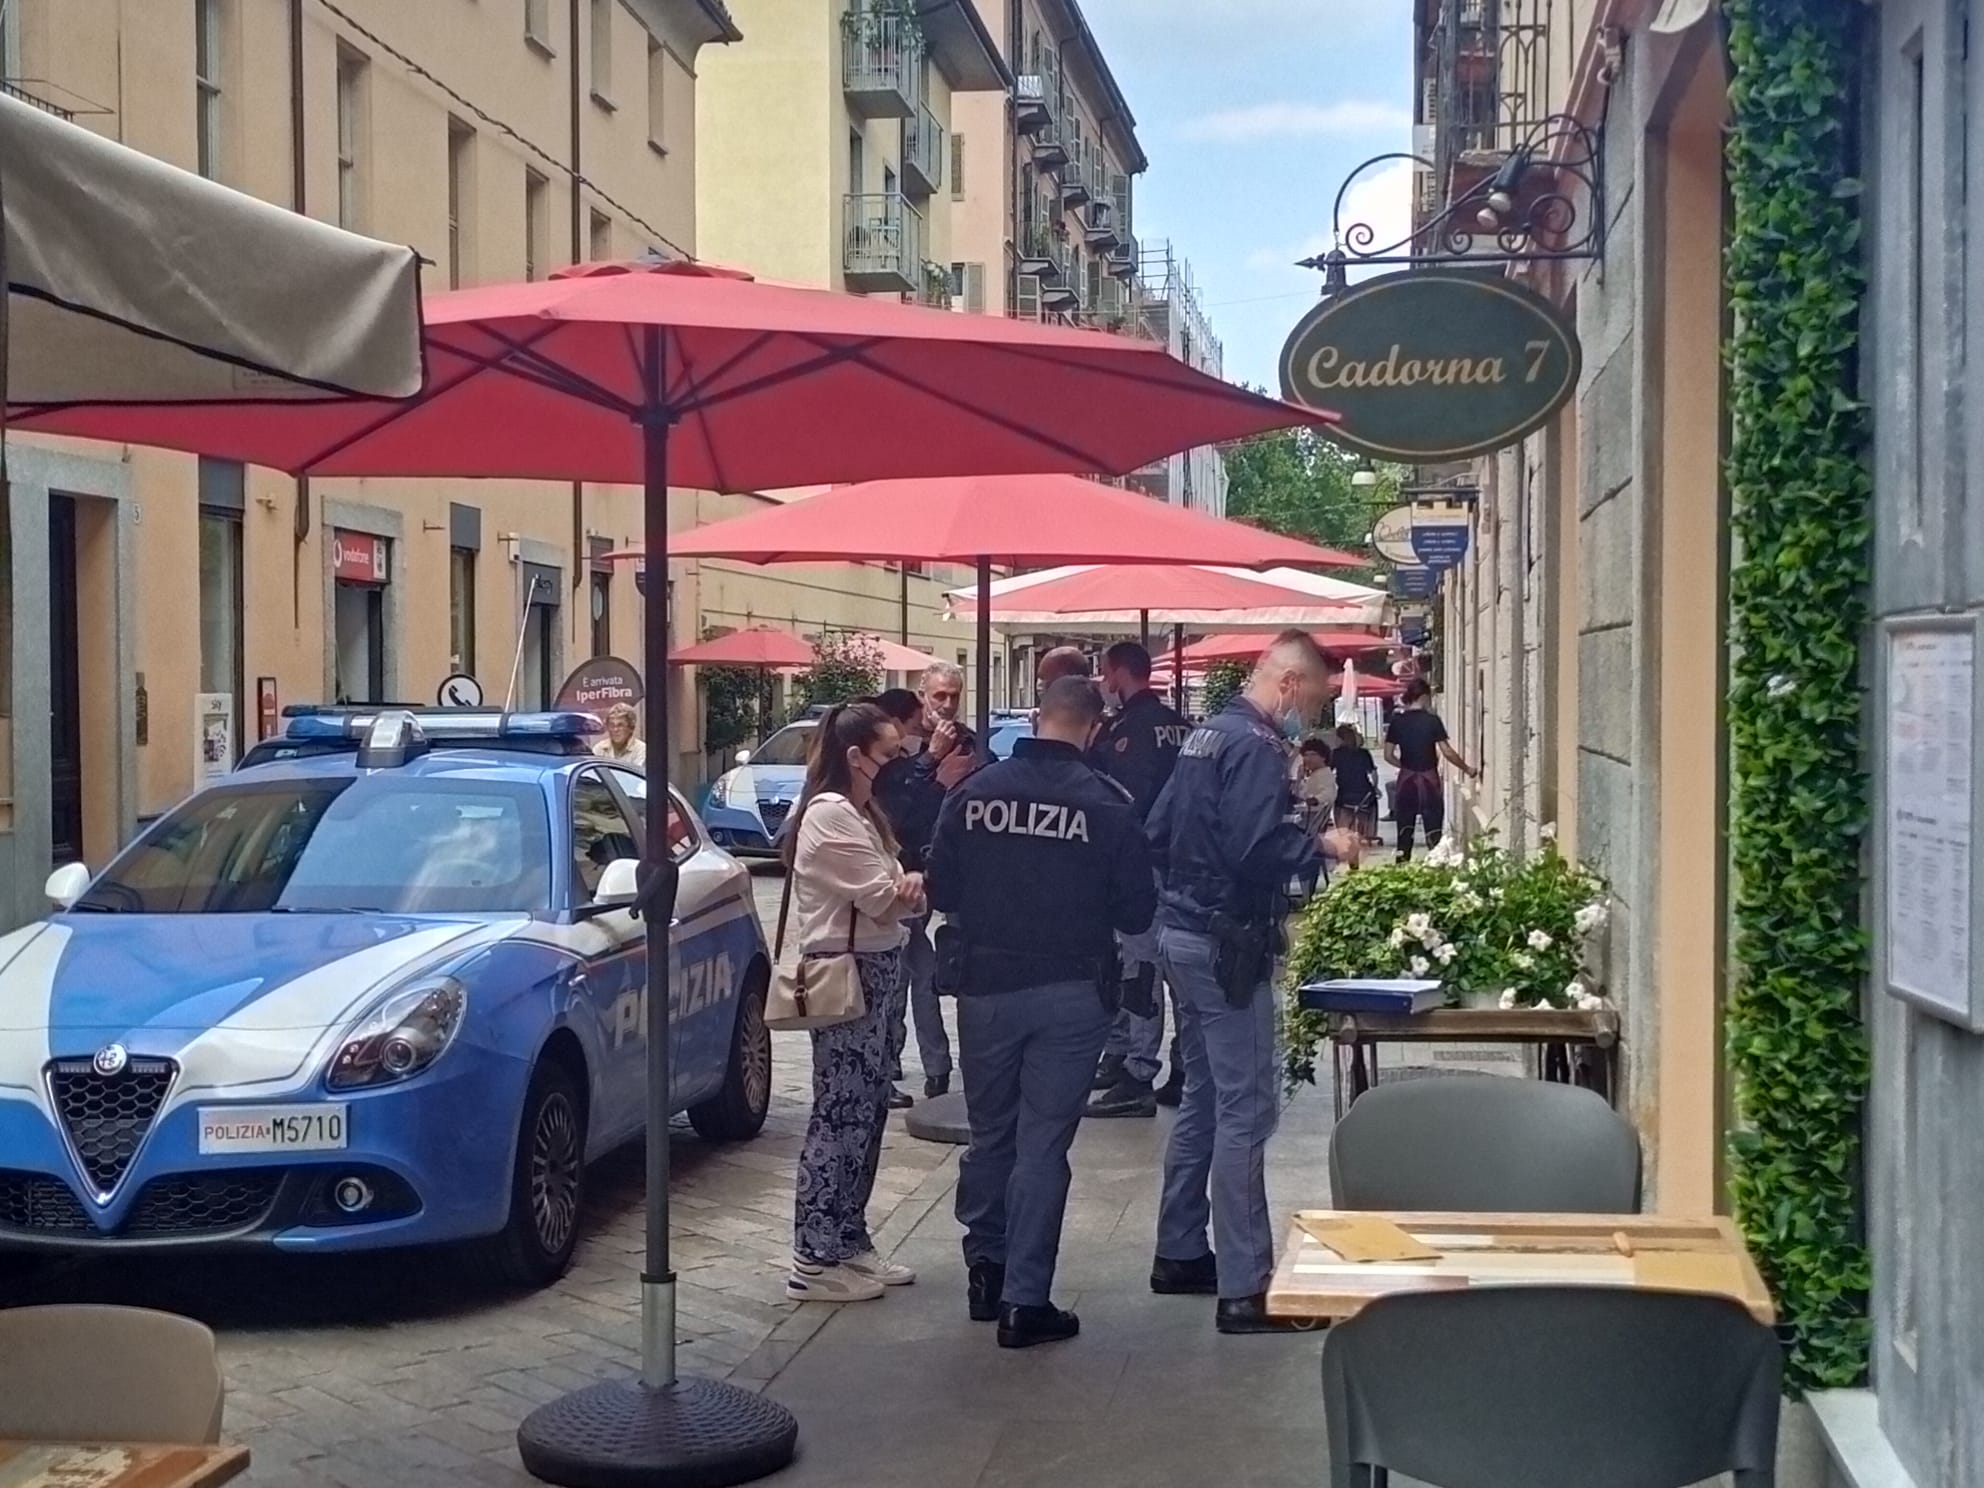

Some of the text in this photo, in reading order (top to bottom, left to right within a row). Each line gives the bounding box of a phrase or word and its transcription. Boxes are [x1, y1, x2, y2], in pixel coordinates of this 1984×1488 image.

[1307, 339, 1551, 389] Cadorna 7
[343, 547, 369, 565] vodafone
[590, 676, 623, 687] arrivata
[576, 687, 633, 704] IperFibra
[965, 799, 1089, 842] POLIZIA
[204, 1114, 342, 1144] POLIZIA M5710
